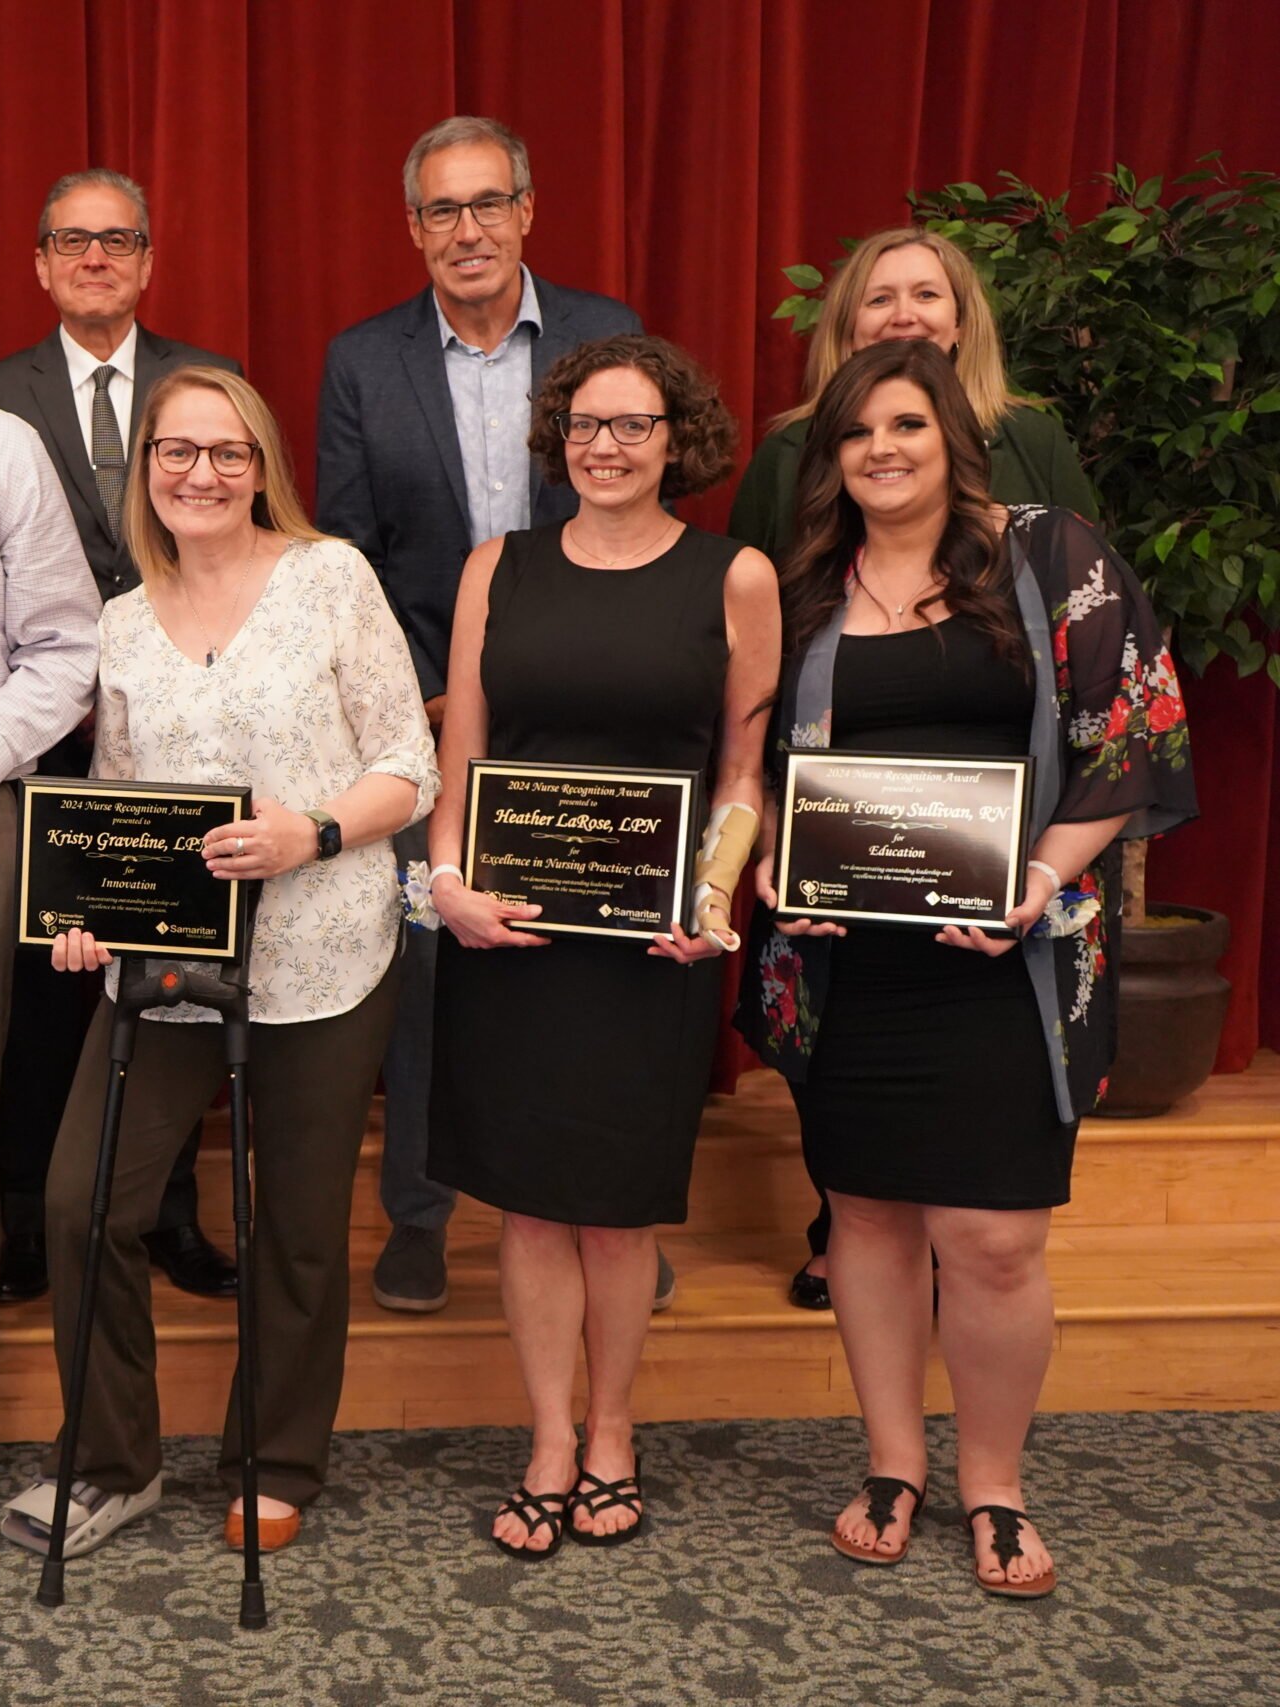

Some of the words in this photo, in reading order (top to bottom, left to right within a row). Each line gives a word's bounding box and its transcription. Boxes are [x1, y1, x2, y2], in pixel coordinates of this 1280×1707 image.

[826, 767, 850, 779] 2024
[852, 769, 882, 779] Nurse
[884, 769, 943, 785] Recognition
[943, 772, 983, 784] Award
[507, 780, 530, 791] 2024
[531, 782, 559, 793] Nurse
[561, 783, 615, 798] Recognition
[616, 786, 652, 798] Award
[60, 799, 83, 810] 2024
[84, 800, 112, 811] Nurse
[114, 802, 168, 816] Recognition
[168, 805, 205, 816] Award
[558, 798, 590, 807] presented
[590, 799, 598, 807] to
[793, 797, 850, 815] Jordain
[853, 800, 905, 820] Forney
[906, 801, 973, 822] Sullivan,
[979, 805, 1011, 823] RN
[112, 816, 143, 826] presented
[494, 808, 555, 826] Heather
[555, 812, 614, 832] LaRose,
[618, 816, 661, 834] LPN
[47, 829, 94, 850] Kristy
[97, 832, 169, 852] Graveline,
[891, 833, 905, 843] for
[568, 847, 580, 857] for
[868, 844, 926, 859] Education
[122, 865, 135, 876] for
[479, 853, 531, 867] Excellence
[532, 856, 543, 868] in
[544, 859, 586, 874] Nursing
[587, 861, 632, 876] Practice;
[634, 864, 671, 878] Clinics
[100, 877, 157, 891] Innovation
[820, 888, 848, 896] Nurses
[940, 894, 993, 906] Samaritan
[613, 907, 661, 919] Samaritan
[58, 918, 84, 926] Nurses
[169, 924, 217, 935] Samaritan
